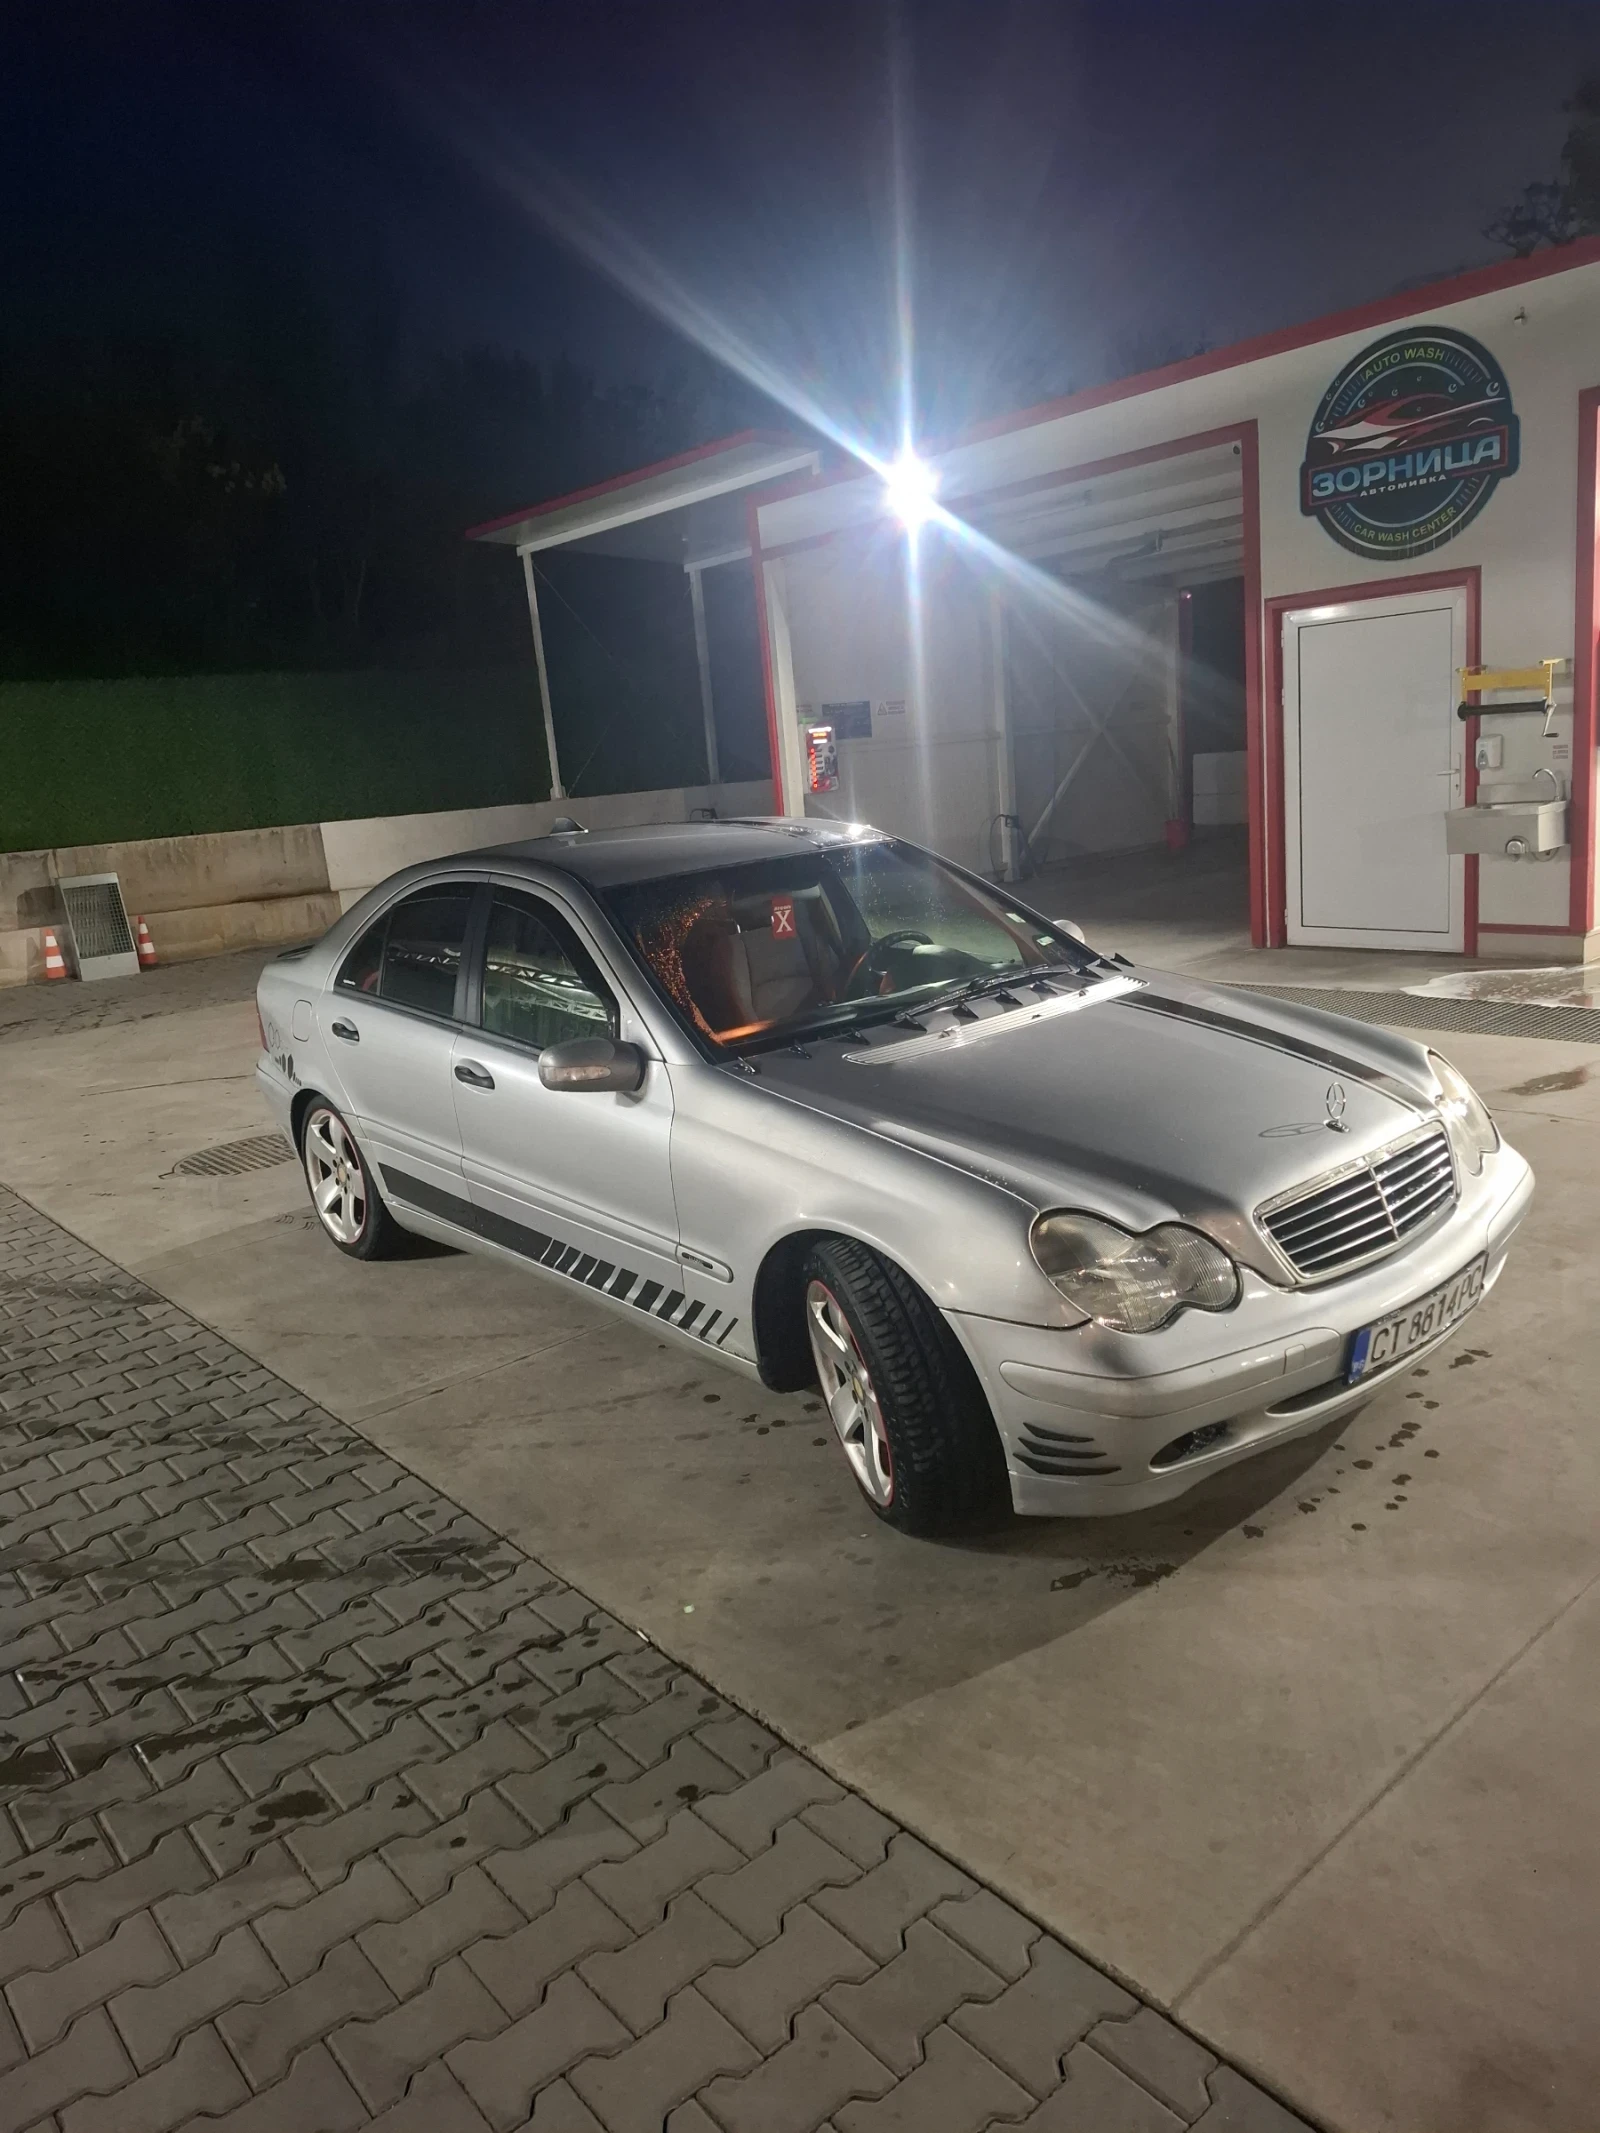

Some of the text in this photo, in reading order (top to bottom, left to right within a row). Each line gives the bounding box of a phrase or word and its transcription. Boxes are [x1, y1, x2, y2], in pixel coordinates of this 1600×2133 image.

[1363, 347, 1445, 381] AUTO WASH
[1312, 435, 1500, 497] ЗОРНИЦА
[1359, 473, 1447, 498] АВТОМИВКА
[1353, 506, 1457, 542] CAR WASH CENTER
[1371, 1317, 1407, 1363] CT
